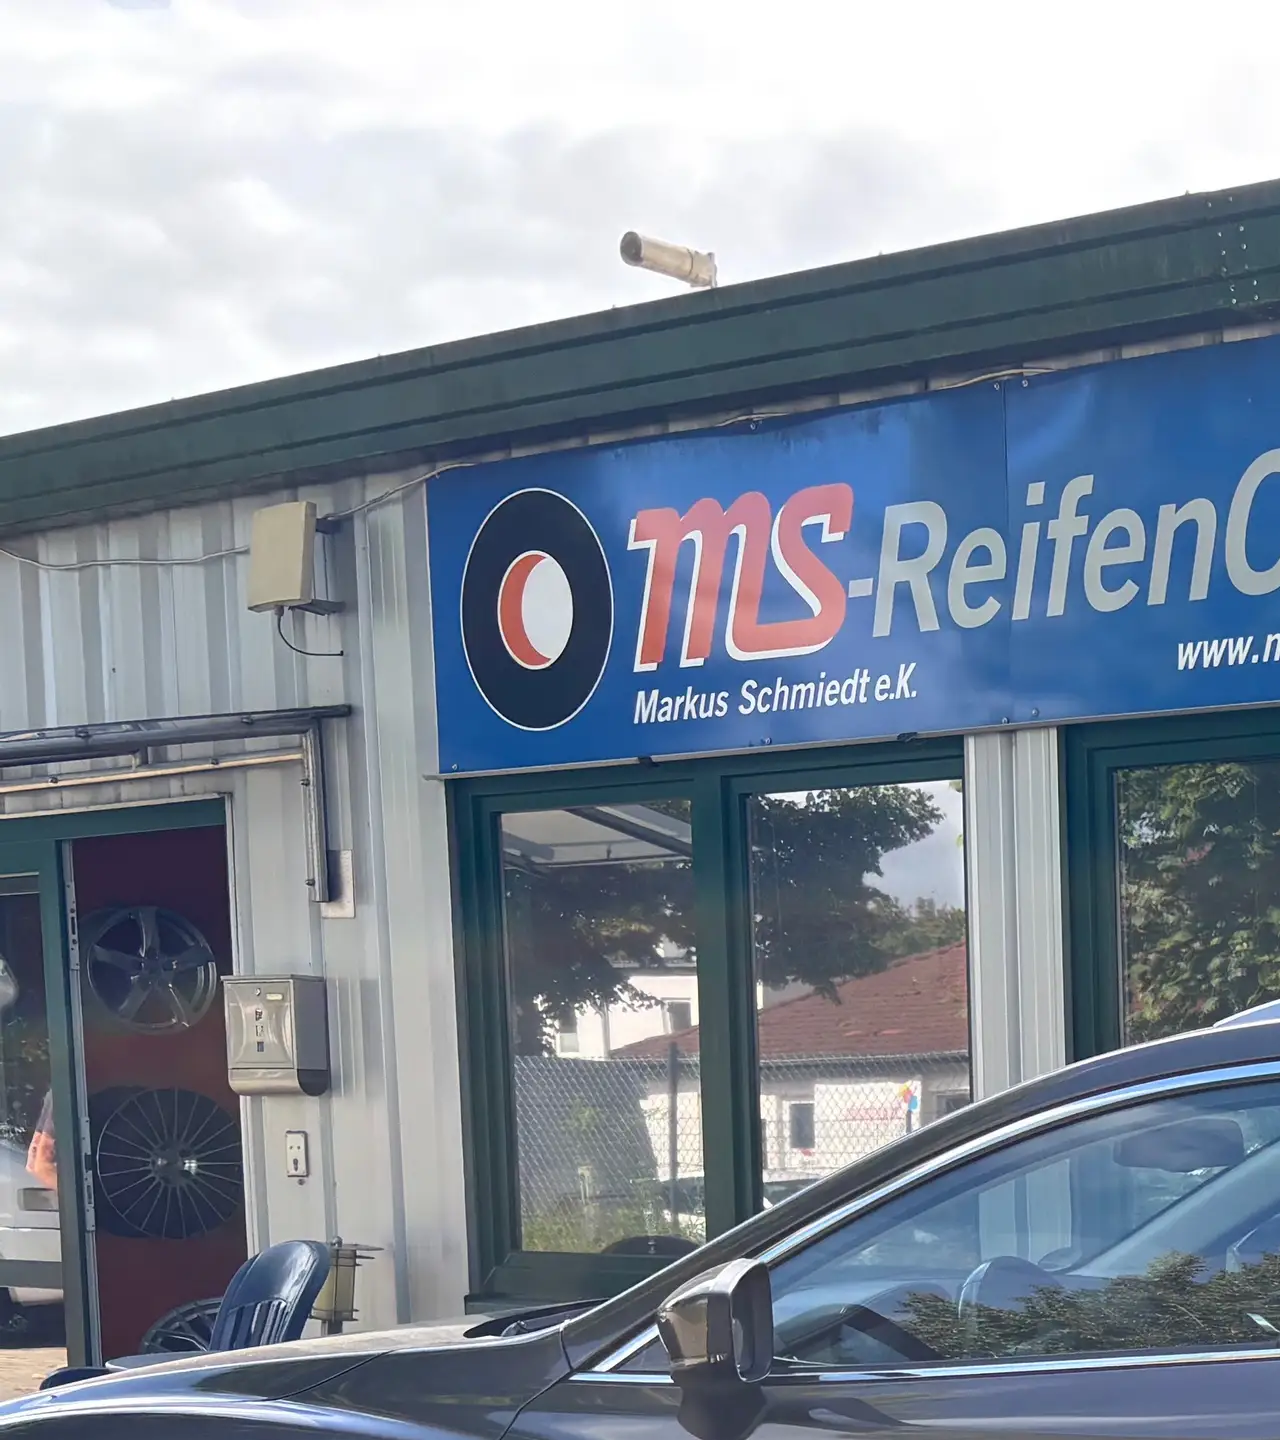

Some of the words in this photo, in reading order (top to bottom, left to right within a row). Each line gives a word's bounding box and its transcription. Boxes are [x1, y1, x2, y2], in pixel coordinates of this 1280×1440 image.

[633, 685, 729, 725] Markus
[739, 670, 870, 716] Schmiedt
[874, 663, 918, 702] e.K.
